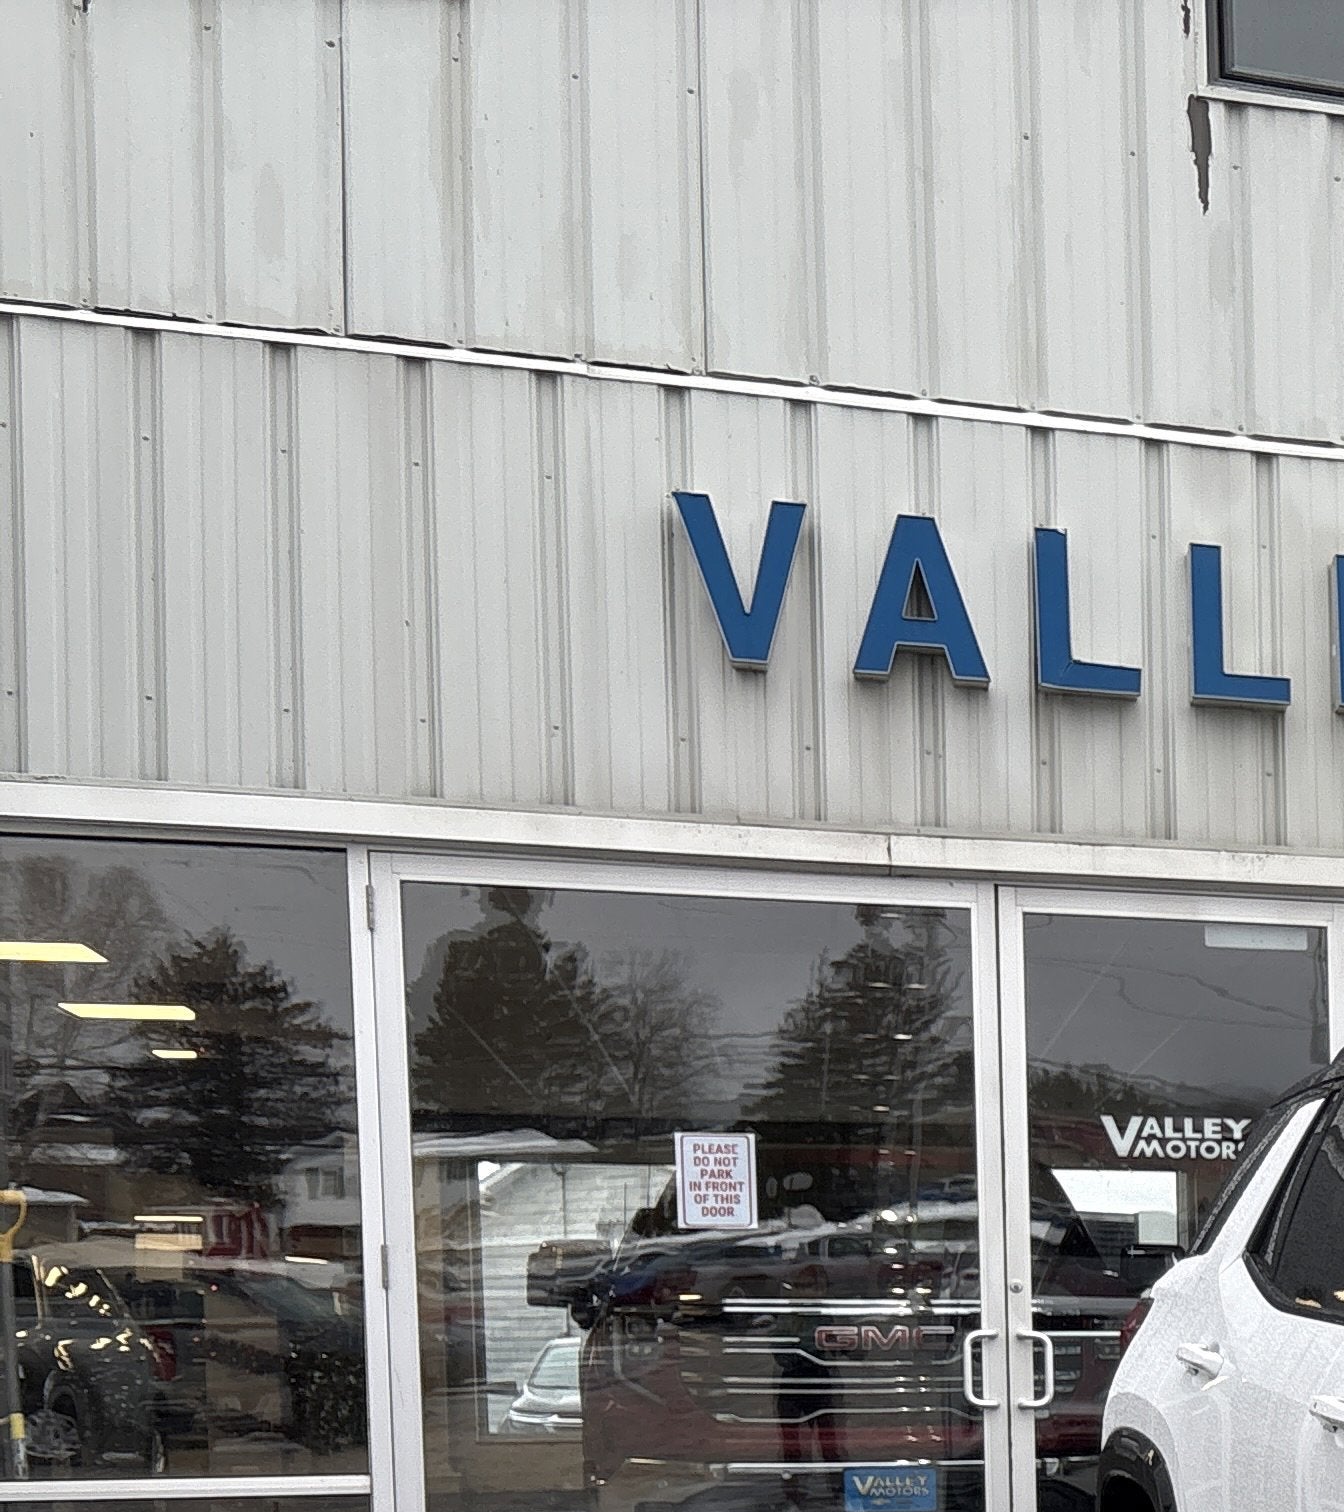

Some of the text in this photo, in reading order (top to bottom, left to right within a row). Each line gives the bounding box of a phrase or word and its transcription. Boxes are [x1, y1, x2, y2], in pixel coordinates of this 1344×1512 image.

[1100, 1114, 1252, 1158] VALLEY
[692, 1143, 738, 1154] PLEASE
[1133, 1139, 1245, 1160] MOTOR
[693, 1156, 738, 1167] DO NOT
[700, 1169, 733, 1179] PARK
[689, 1181, 745, 1192] IN FRONT
[694, 1193, 741, 1204] OF THIS
[701, 1206, 735, 1217] DOOR
[815, 1325, 954, 1350] GMC
